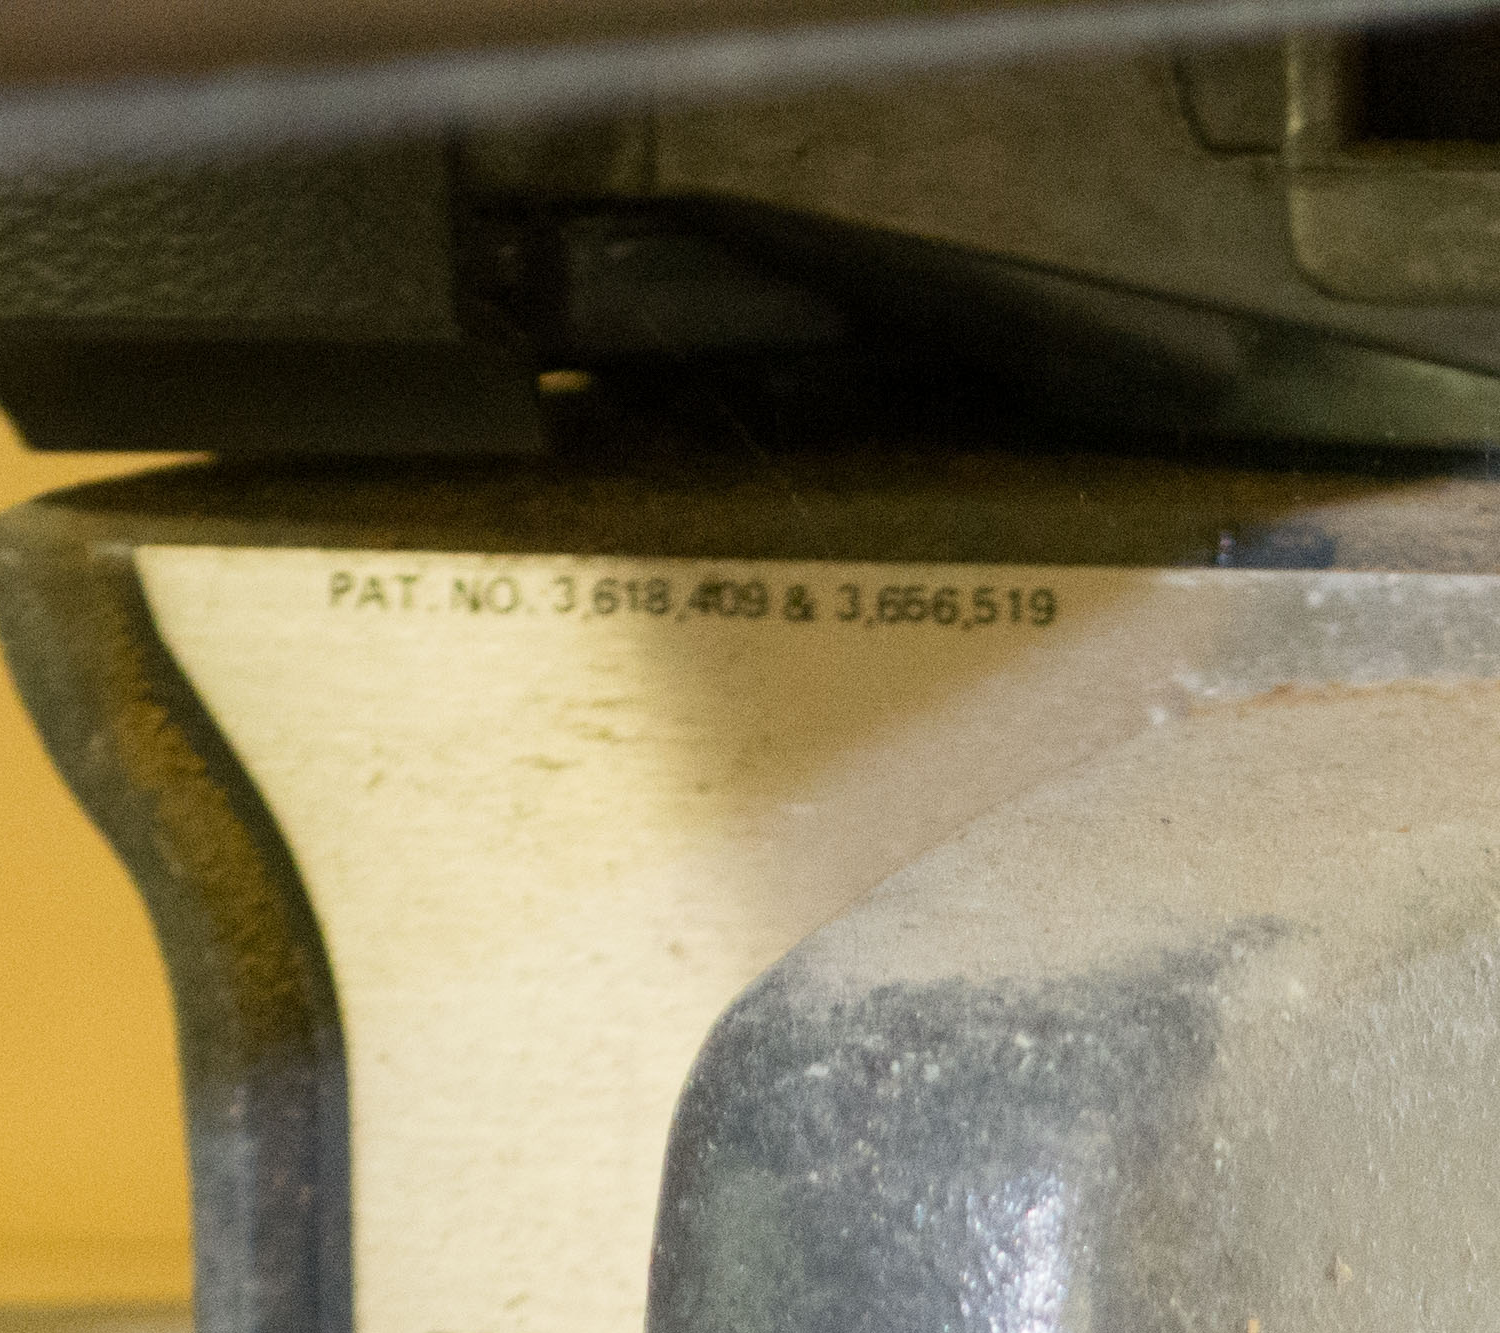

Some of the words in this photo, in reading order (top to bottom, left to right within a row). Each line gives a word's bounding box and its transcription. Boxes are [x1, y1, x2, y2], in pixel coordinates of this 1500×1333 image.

[330, 571, 439, 612] PAT.
[450, 575, 536, 616] NO.
[783, 583, 816, 623] &
